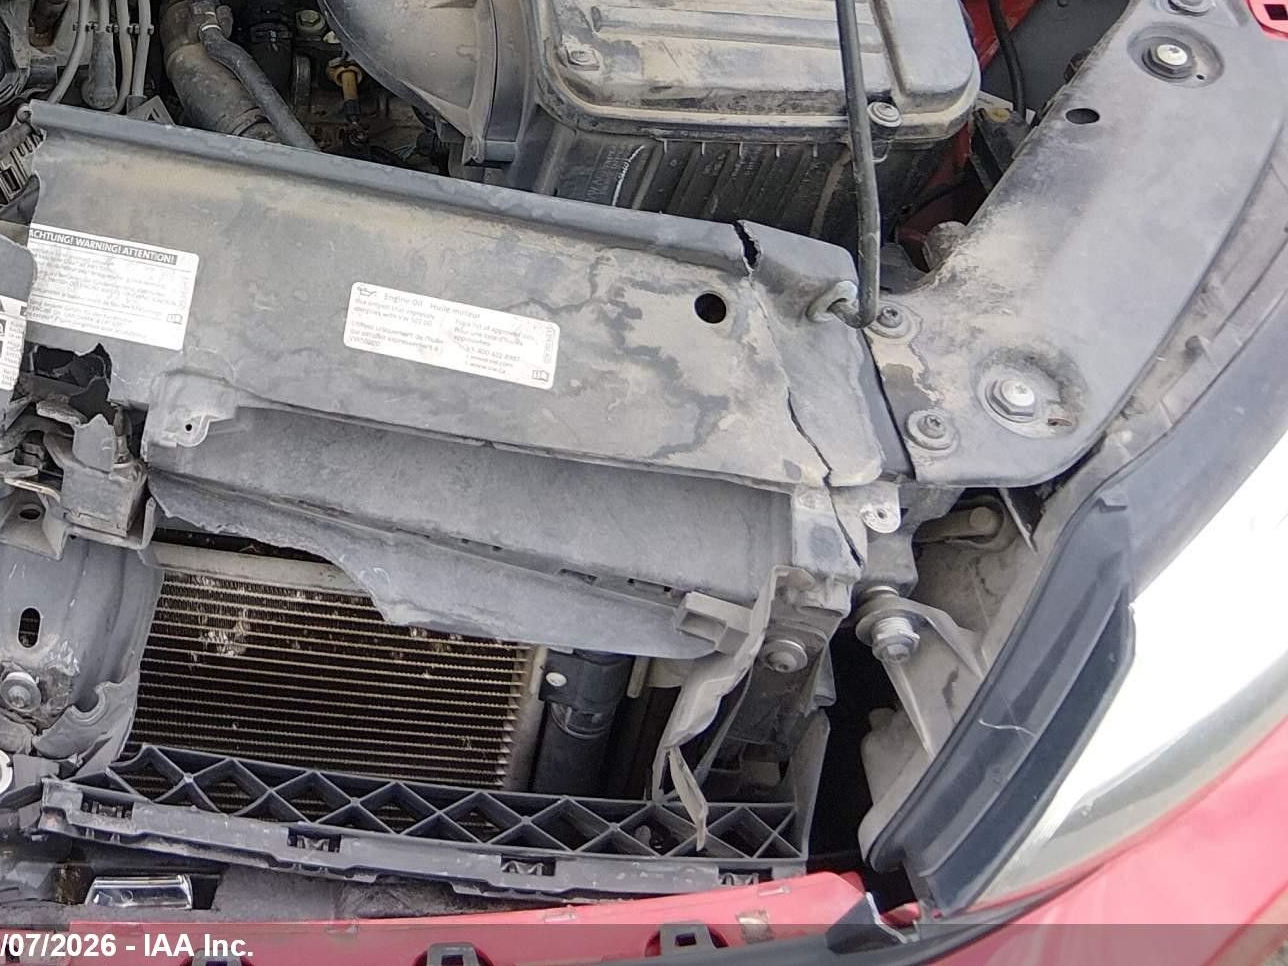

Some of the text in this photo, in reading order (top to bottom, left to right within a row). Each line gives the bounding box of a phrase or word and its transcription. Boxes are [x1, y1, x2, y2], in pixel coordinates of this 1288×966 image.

[29, 228, 175, 264] ACHTUNG! WARNING! ATTENTION!
[383, 292, 410, 306] Engine
[412, 299, 423, 307] Oil
